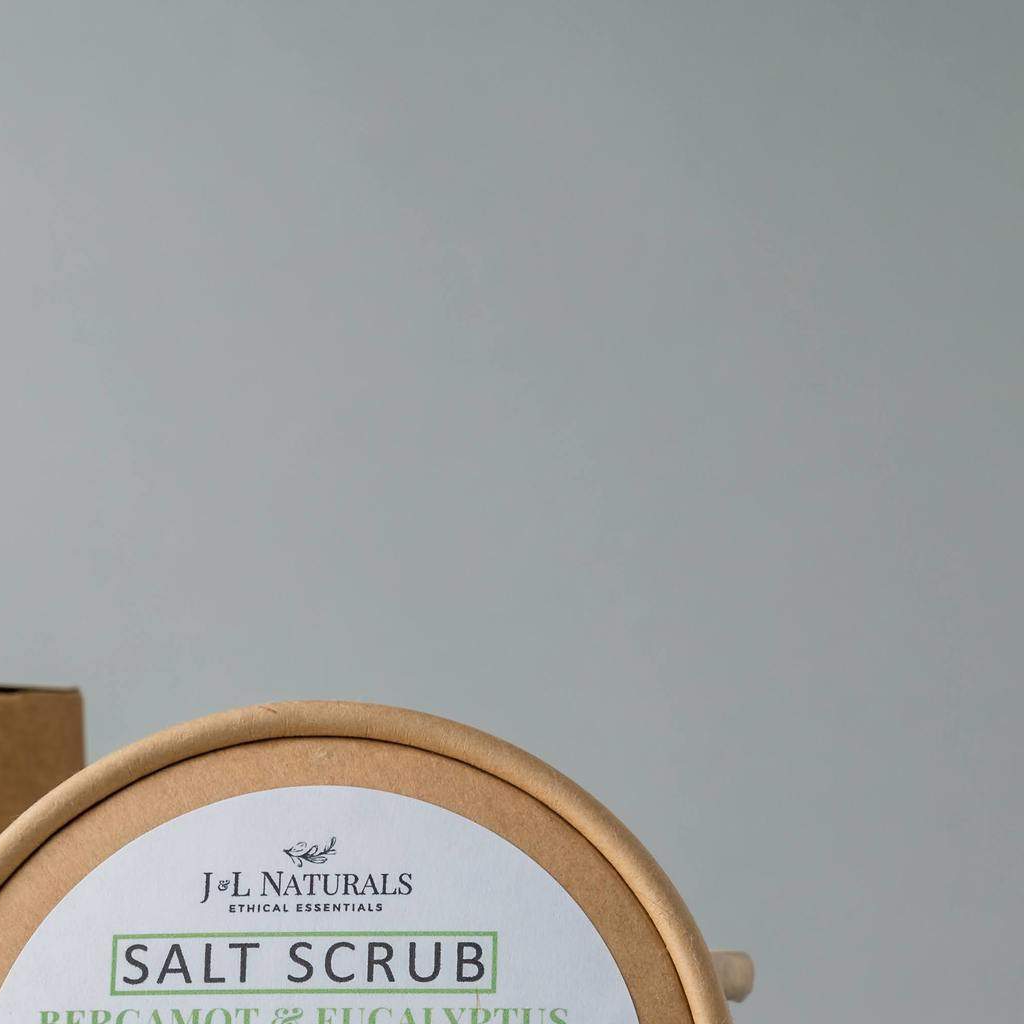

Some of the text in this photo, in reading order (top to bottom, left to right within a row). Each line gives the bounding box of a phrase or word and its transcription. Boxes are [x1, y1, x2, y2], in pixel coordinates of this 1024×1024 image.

[200, 871, 251, 903] J&L
[228, 903, 383, 913] ETHICAL ESSENTIALS
[122, 941, 486, 986] SALT SCRUB
